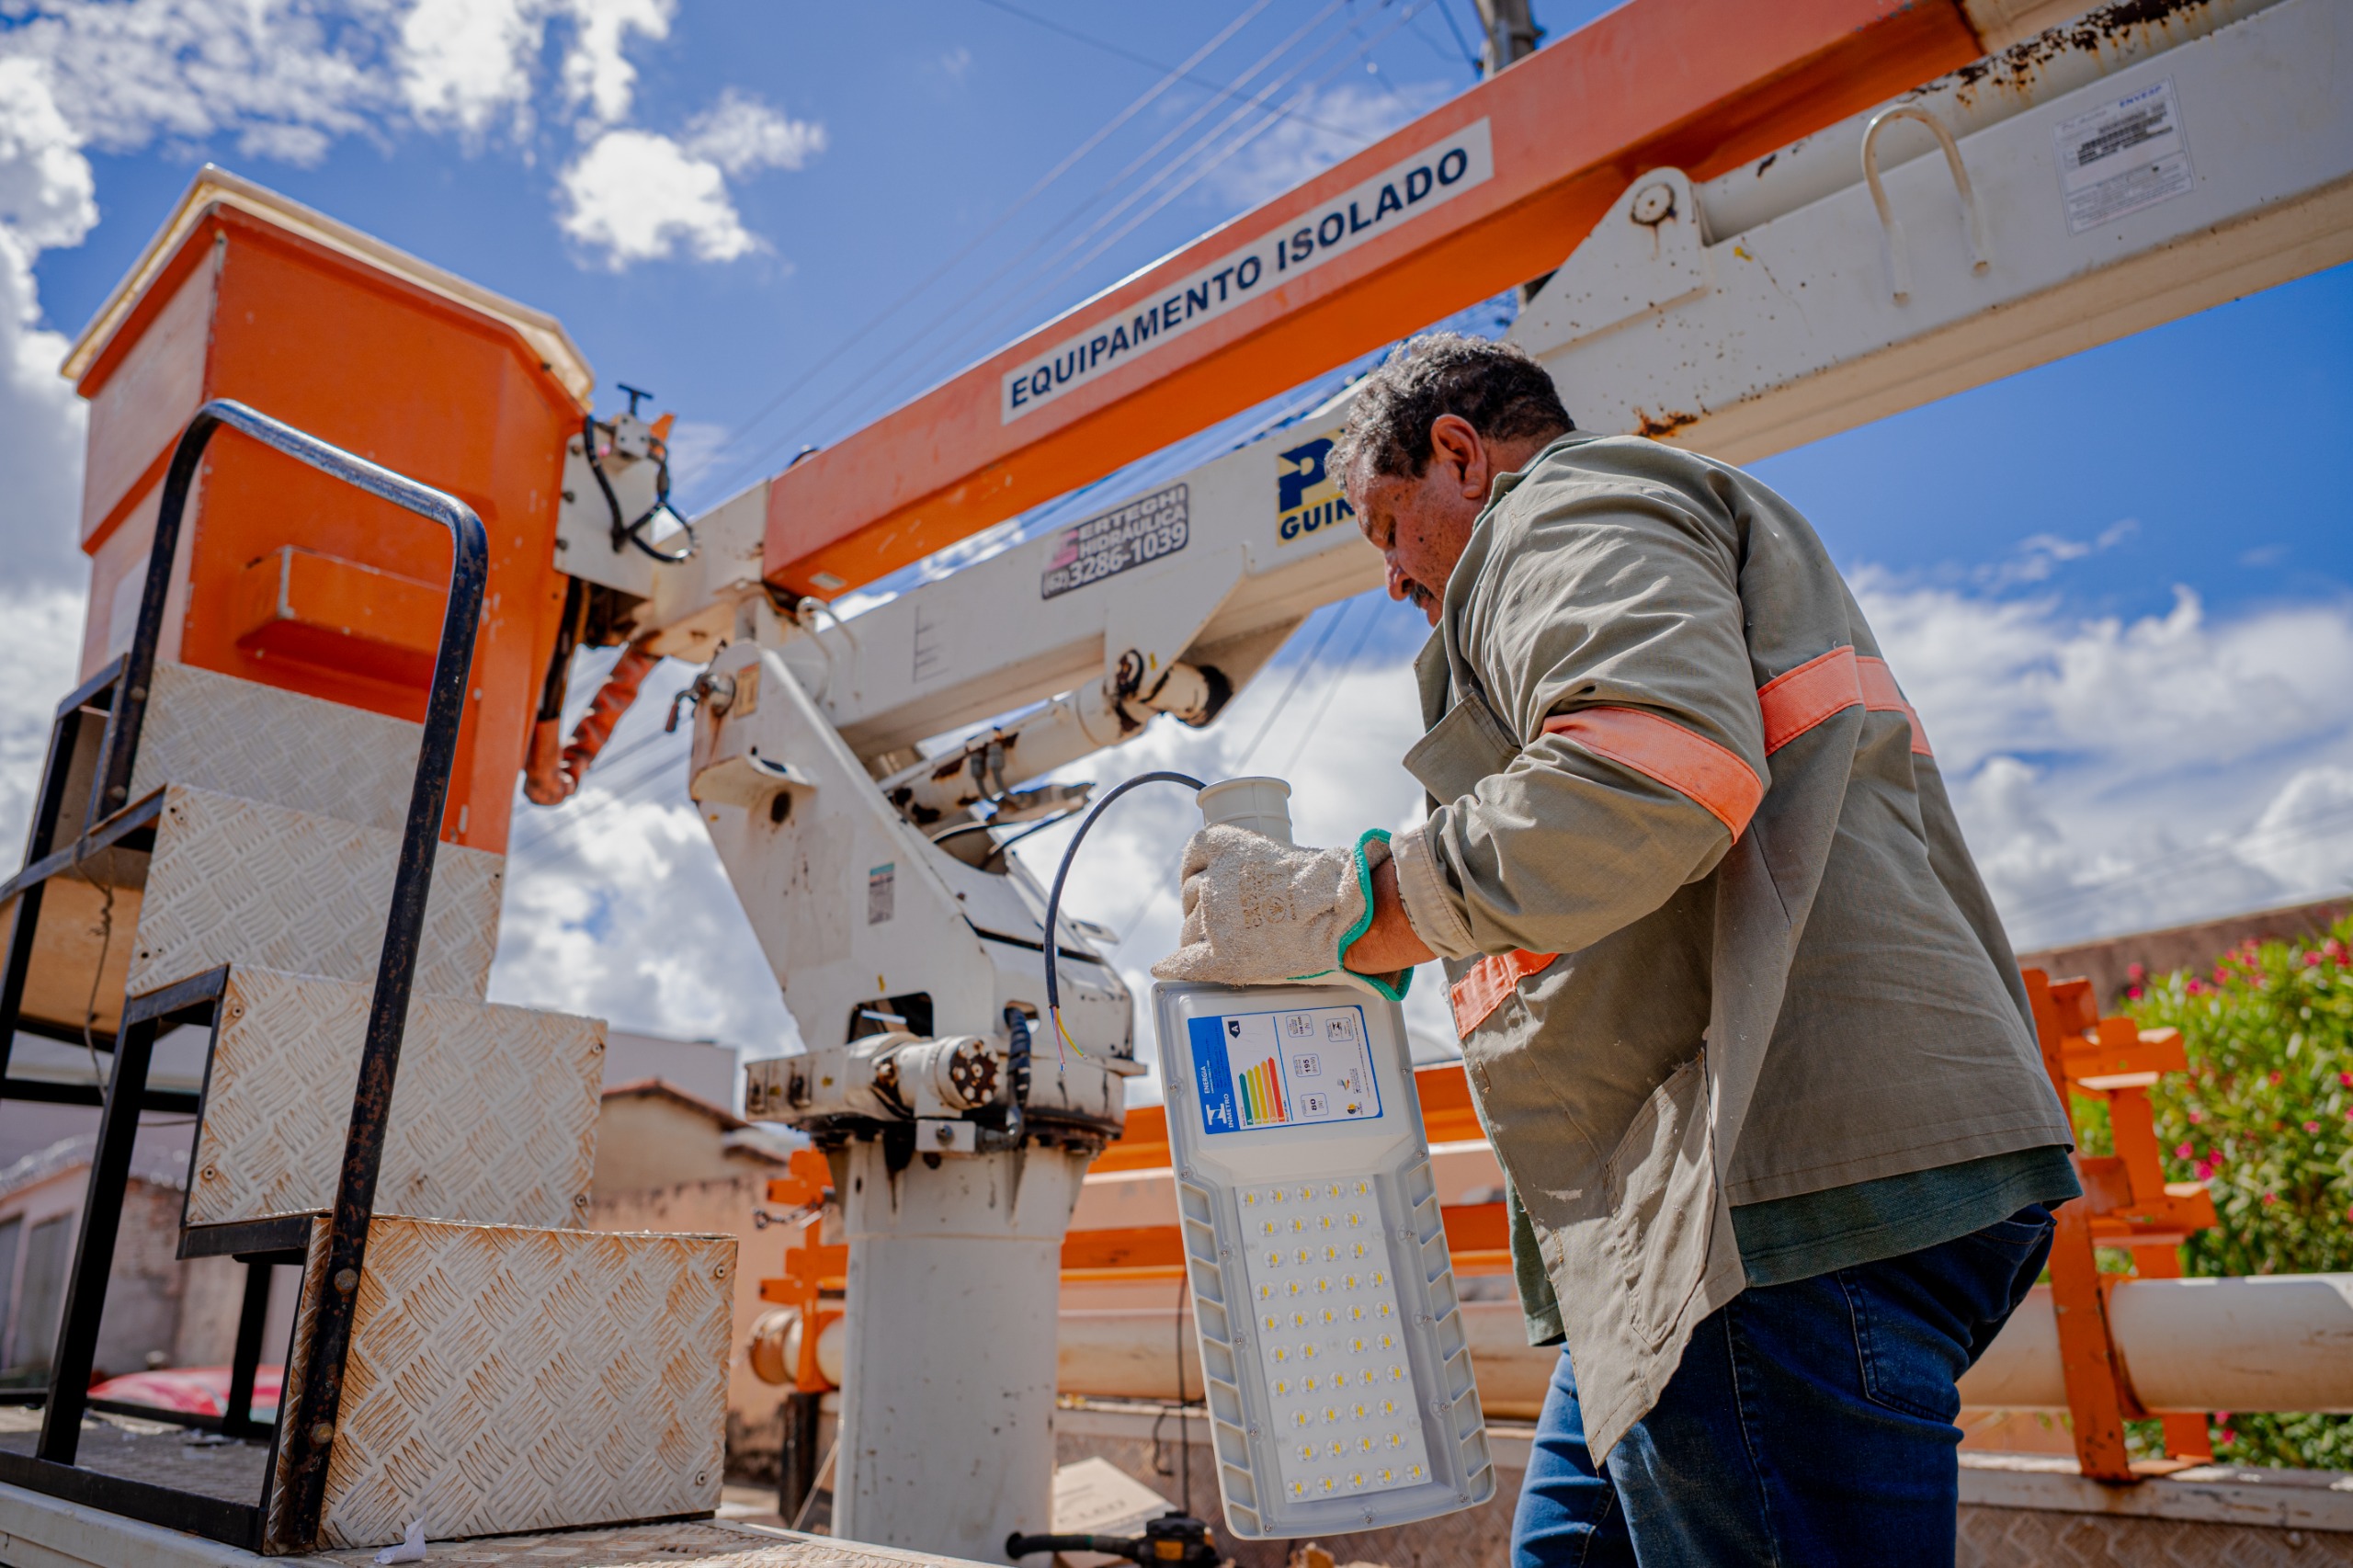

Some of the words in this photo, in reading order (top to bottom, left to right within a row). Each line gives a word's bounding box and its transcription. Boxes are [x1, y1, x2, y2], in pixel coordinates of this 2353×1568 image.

[1010, 256, 1261, 410] EQUIPAMENTO
[1278, 147, 1469, 272] ISOLADO
[1279, 429, 1345, 514] P
[1068, 522, 1188, 589] 3286-1039
[1200, 1065, 1211, 1094] ENERGIA
[1310, 1098, 1317, 1111] 80
[1223, 1093, 1234, 1129] INMETRO
